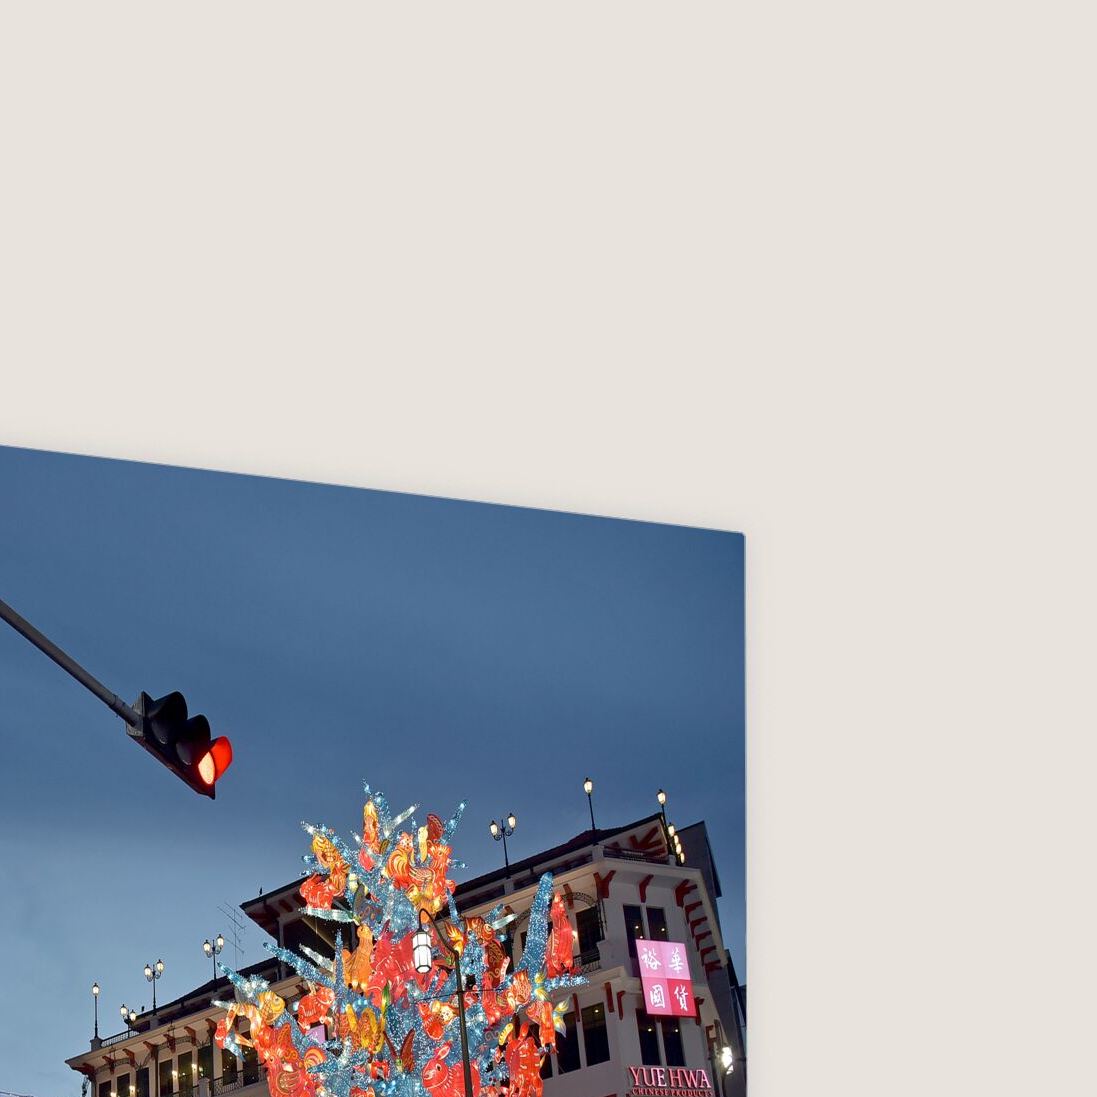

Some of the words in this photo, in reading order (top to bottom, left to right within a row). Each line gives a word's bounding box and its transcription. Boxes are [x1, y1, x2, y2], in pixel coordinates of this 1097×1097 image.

[641, 947, 684, 974] 裕華
[629, 1066, 667, 1087] YUE
[668, 1068, 712, 1089] HWA
[632, 1087, 669, 1097] CHINESE
[670, 1088, 713, 1097] PRODUCTS
